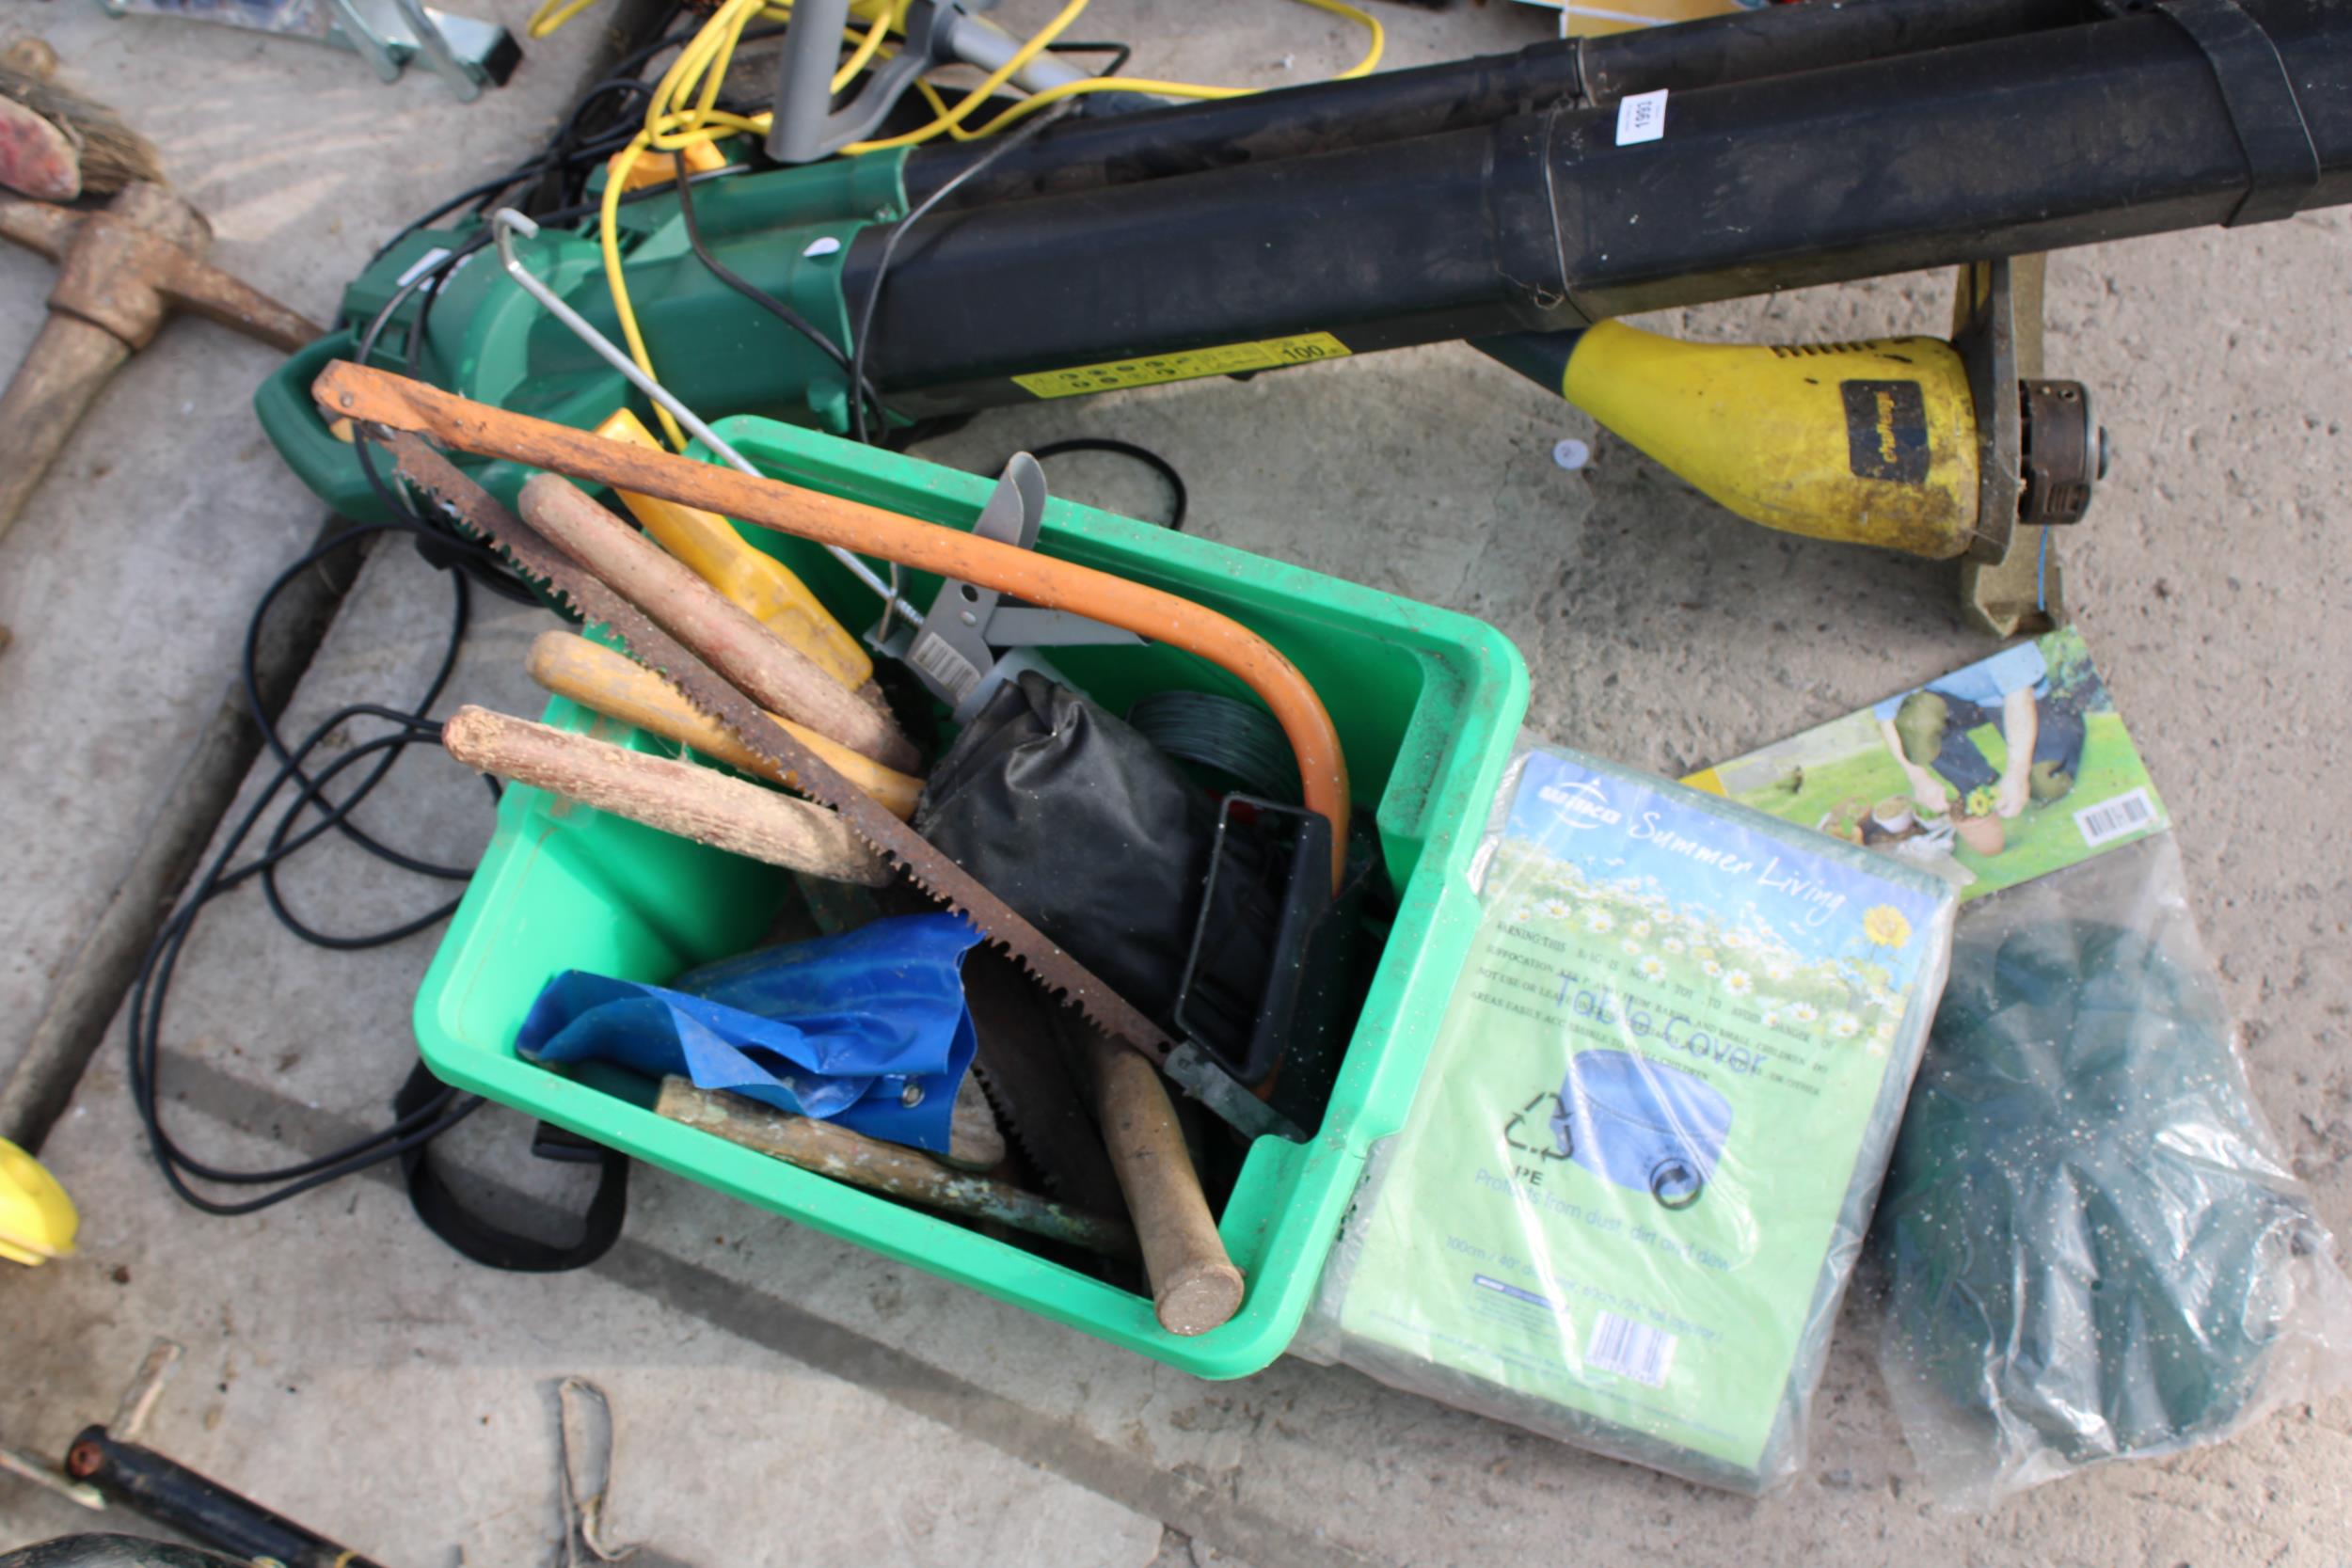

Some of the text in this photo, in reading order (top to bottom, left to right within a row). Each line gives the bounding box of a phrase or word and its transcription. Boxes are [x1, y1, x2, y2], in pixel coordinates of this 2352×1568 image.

[1282, 344, 1325, 359] 100
[1629, 812, 1847, 927] Summer Living
[1554, 974, 1769, 1079] Table Cover
[1515, 1164, 1545, 1186] PE
